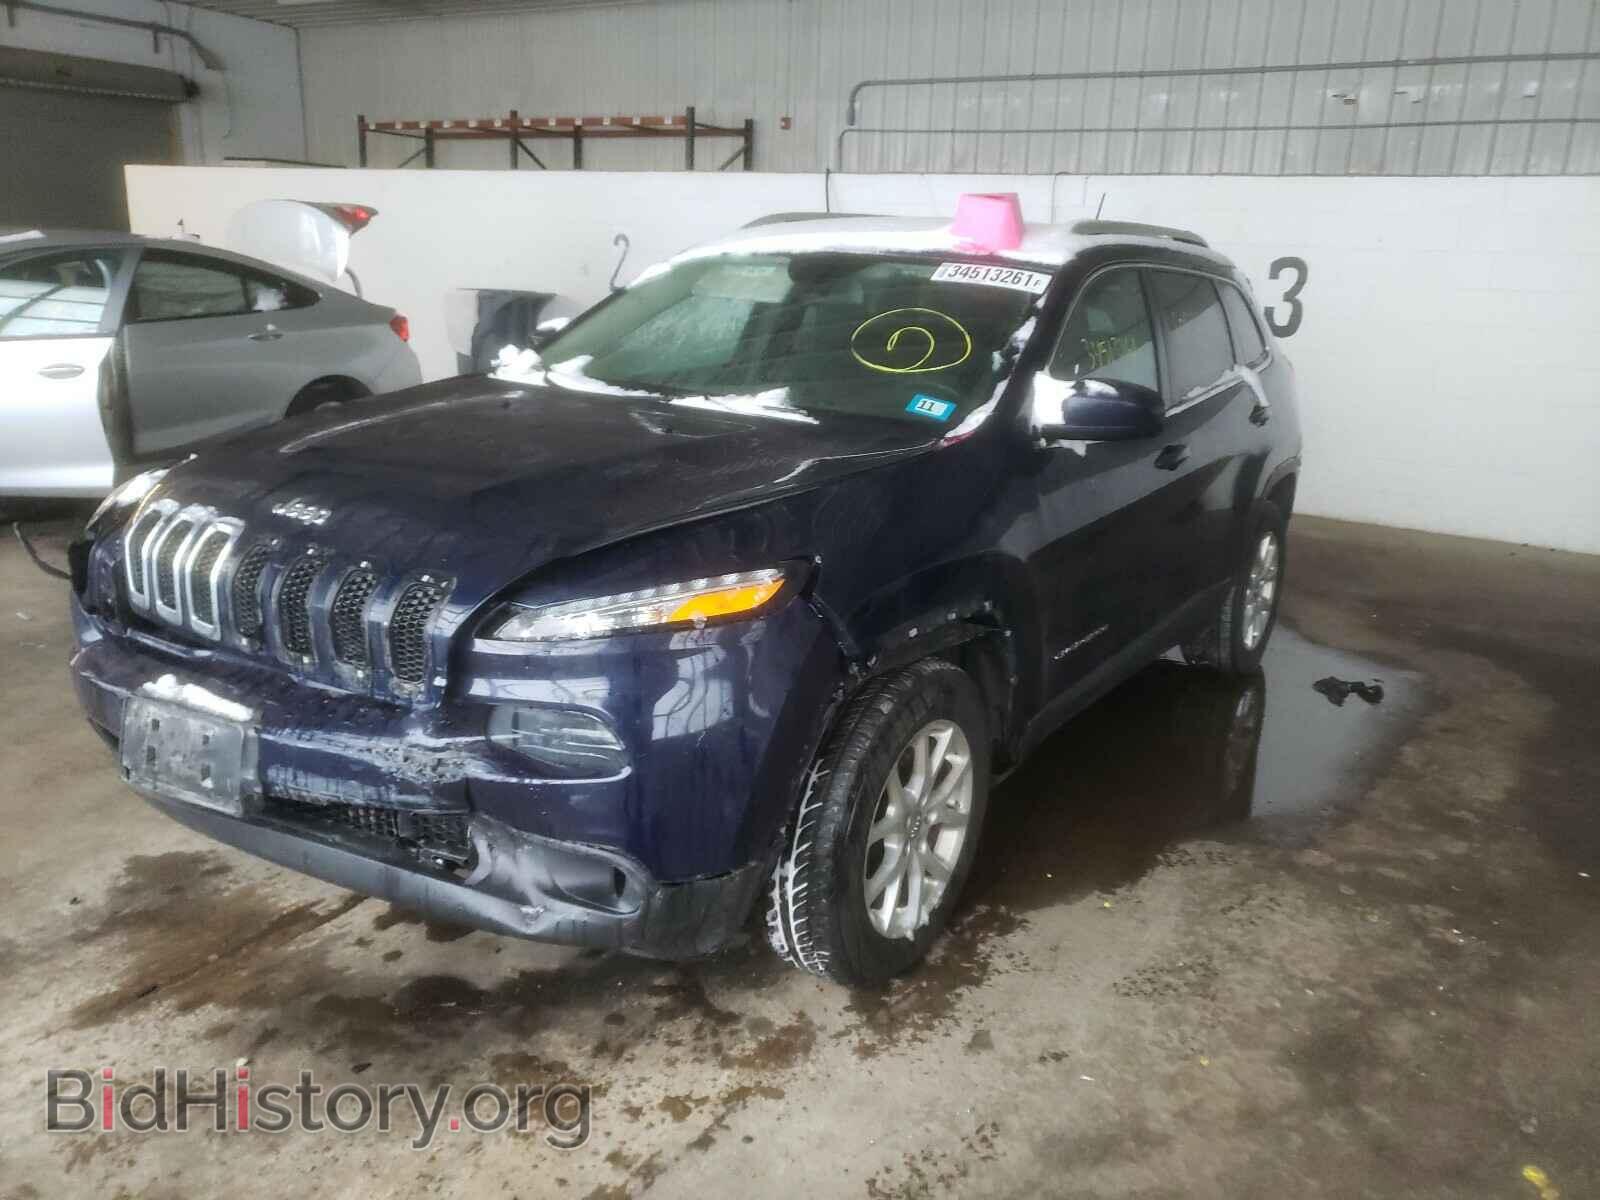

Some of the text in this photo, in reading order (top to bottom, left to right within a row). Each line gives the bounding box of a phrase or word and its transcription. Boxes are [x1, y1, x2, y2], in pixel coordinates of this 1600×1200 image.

[948, 265, 1034, 287] 34513261
[1264, 256, 1308, 338] 3
[916, 400, 935, 411] 11
